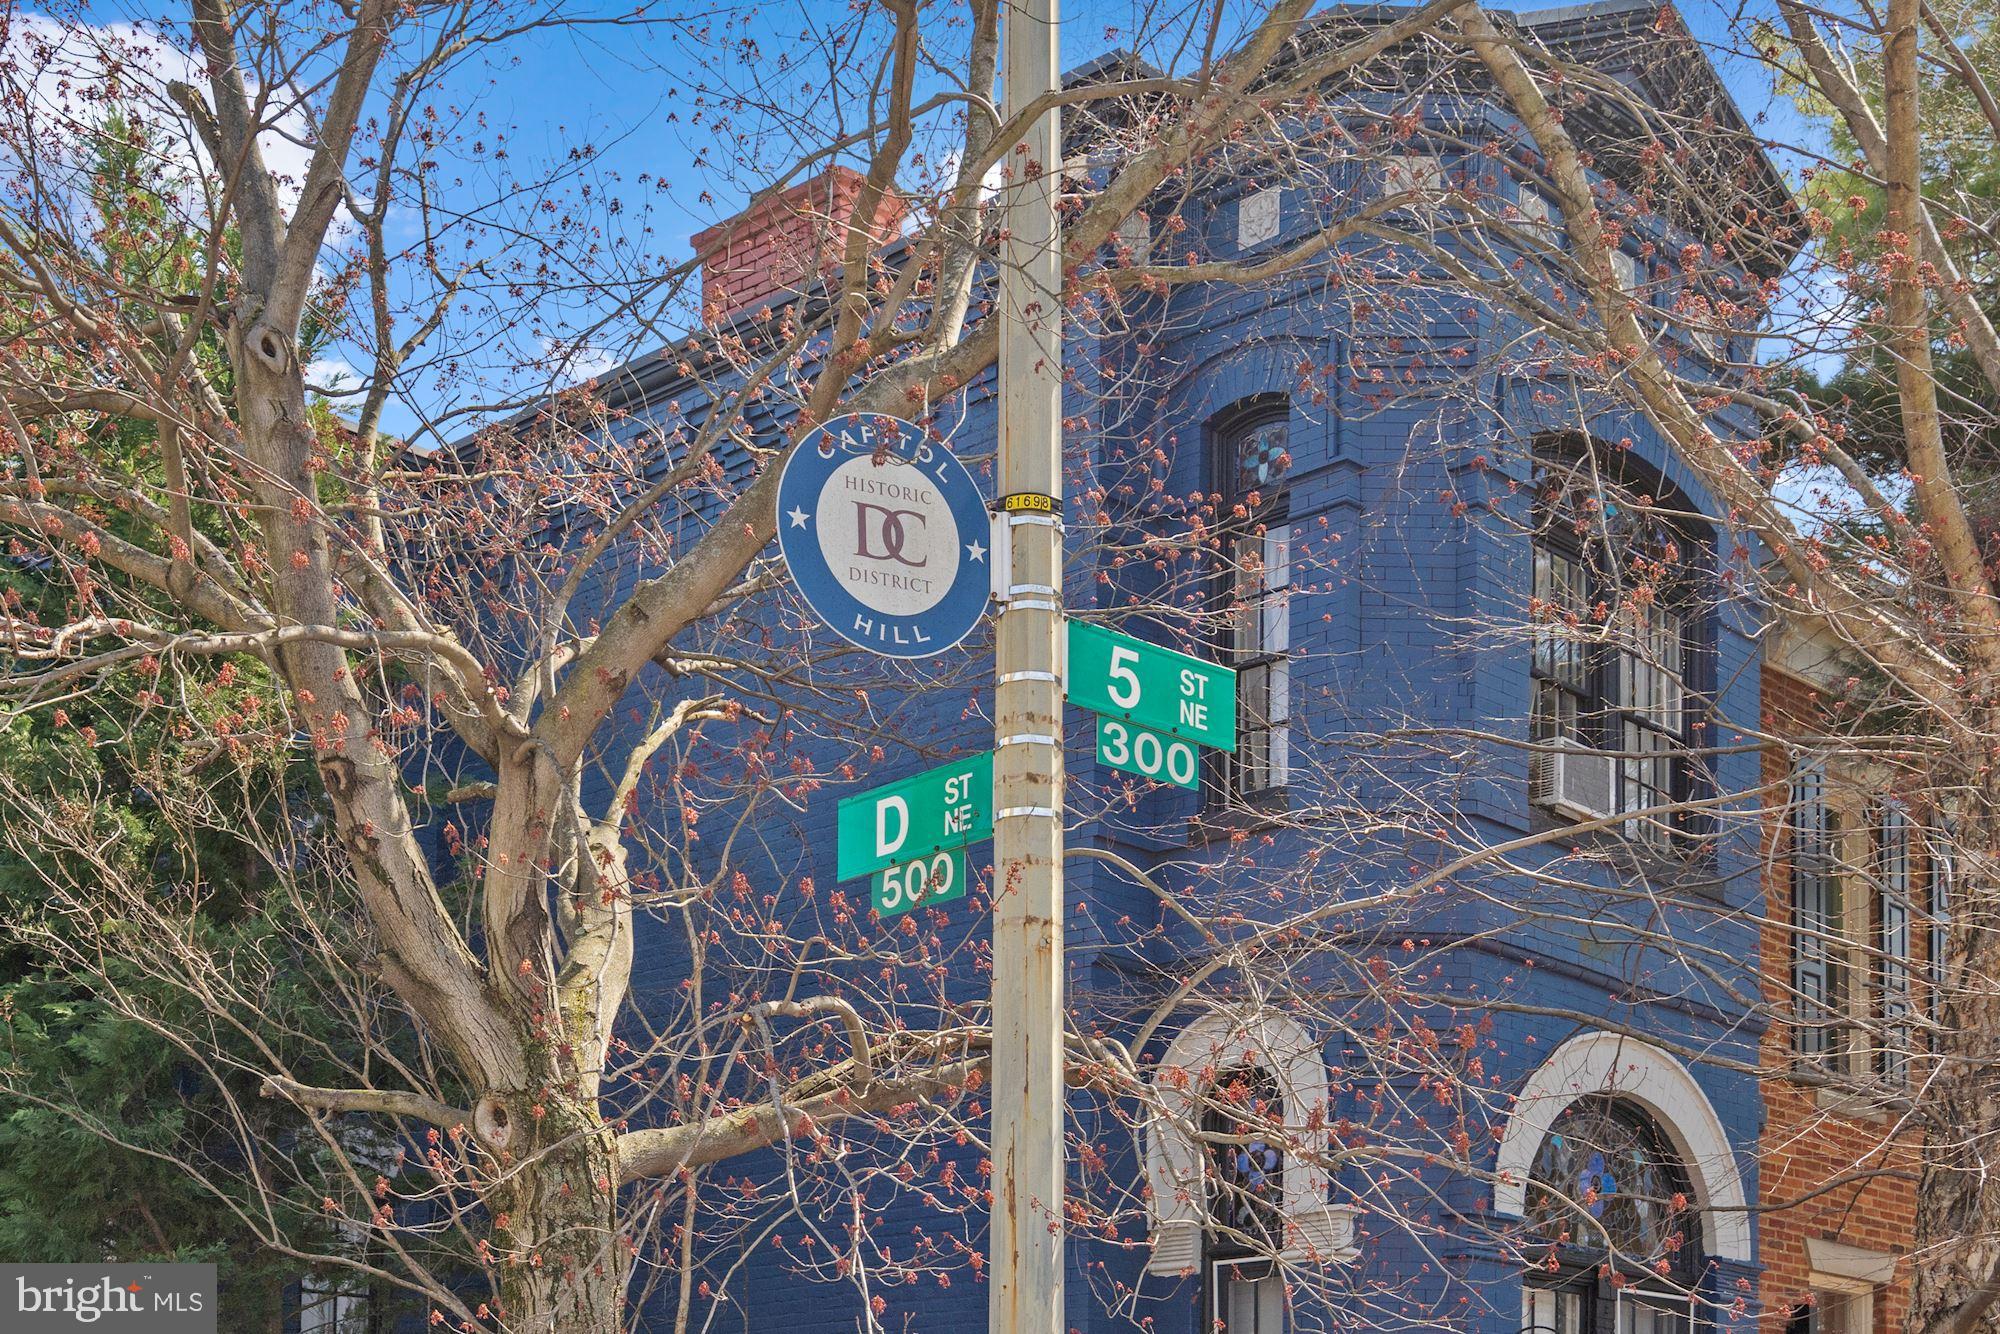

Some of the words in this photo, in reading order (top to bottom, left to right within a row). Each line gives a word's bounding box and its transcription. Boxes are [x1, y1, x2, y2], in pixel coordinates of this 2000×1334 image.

[817, 425, 949, 484] CAPTOL
[845, 475, 932, 505] HISTORIC
[1006, 495, 1049, 509] 61698
[851, 500, 927, 567] DC
[849, 566, 933, 594] DISTRICT
[853, 613, 931, 644] HILL
[1107, 646, 1141, 709] 5
[1179, 668, 1209, 701] ST
[1179, 699, 1208, 731] NE
[1102, 722, 1195, 785] 300
[876, 795, 909, 857] D
[944, 772, 973, 805] ST
[944, 804, 972, 836] NE
[881, 852, 954, 909] 500
